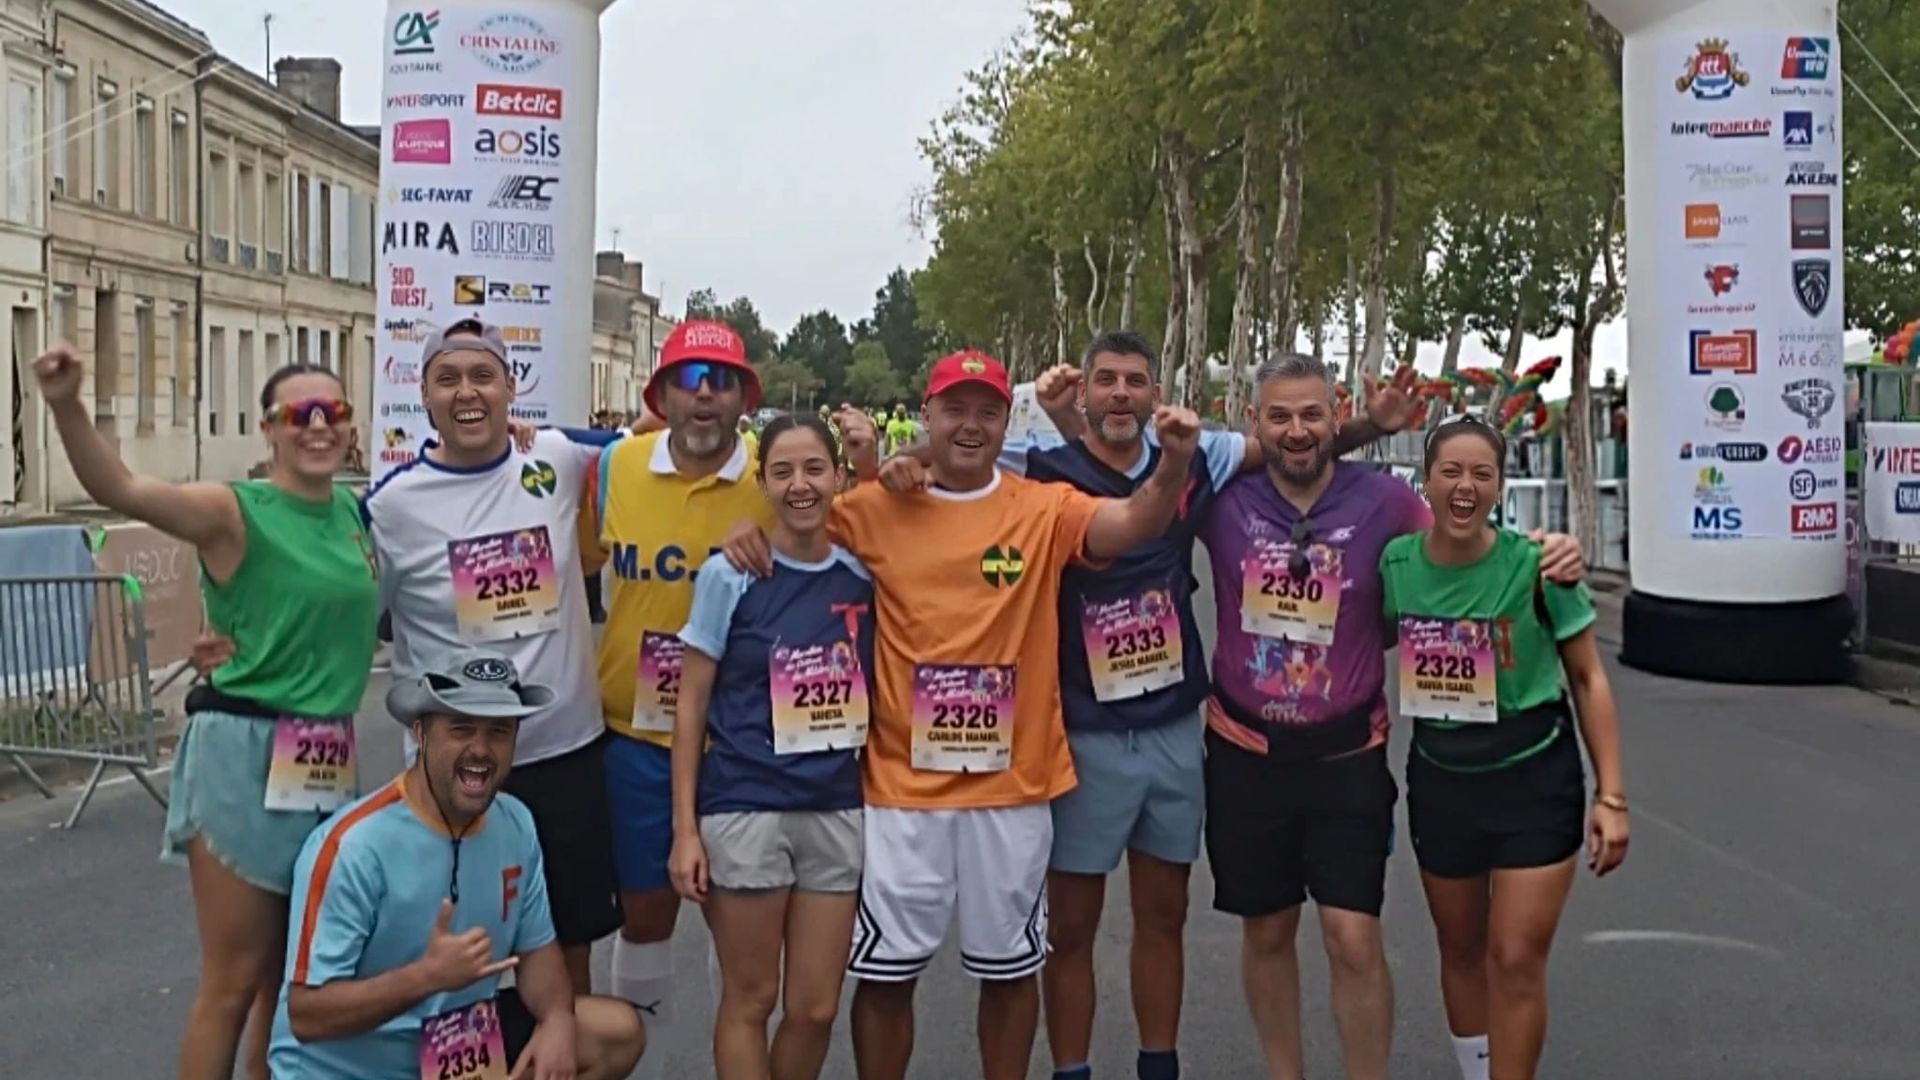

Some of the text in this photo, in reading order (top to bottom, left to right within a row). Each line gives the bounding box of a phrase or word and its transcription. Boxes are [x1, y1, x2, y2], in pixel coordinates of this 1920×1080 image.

[460, 34, 559, 55] CRISTALINE
[481, 90, 558, 115] Betclic
[474, 125, 561, 158] aosis
[401, 188, 473, 203] SEG-FAYAT
[471, 221, 555, 256] RIEDEL
[391, 267, 415, 286] SUD
[390, 287, 427, 307] OUEST
[1694, 507, 1742, 529] MS
[1797, 507, 1834, 528] RMC
[474, 568, 541, 601] 2332
[1260, 571, 1323, 604] 2330
[831, 603, 868, 639] T
[1105, 625, 1166, 659] 2333
[1415, 653, 1477, 680] 2328
[793, 680, 852, 708] 2327
[932, 703, 998, 729] 2326
[502, 864, 522, 922] F
[438, 1042, 490, 1080] 2334
